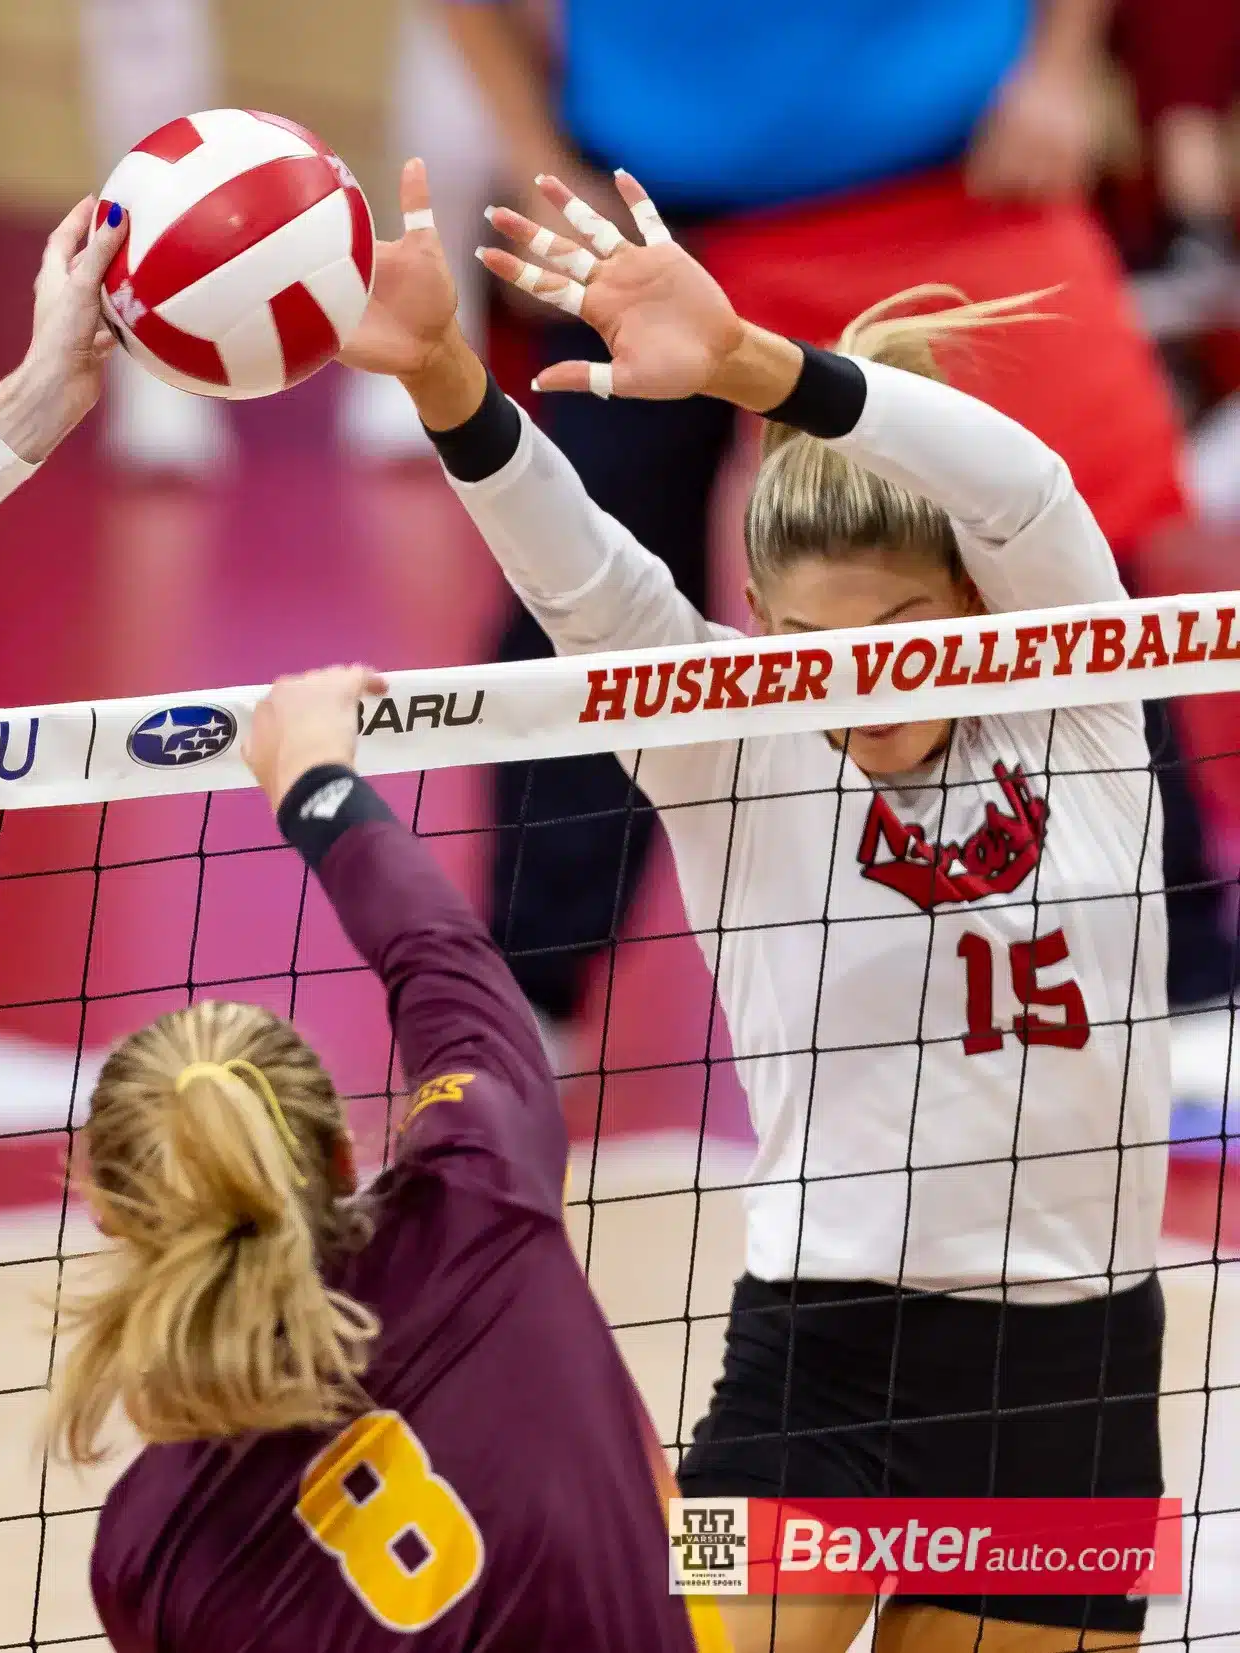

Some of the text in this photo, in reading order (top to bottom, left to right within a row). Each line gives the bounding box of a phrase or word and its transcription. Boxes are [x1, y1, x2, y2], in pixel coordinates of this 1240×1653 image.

[579, 607, 1240, 723] HUSKER VOLLEYBALL
[957, 927, 1091, 1056] 15
[292, 1409, 486, 1634] 8
